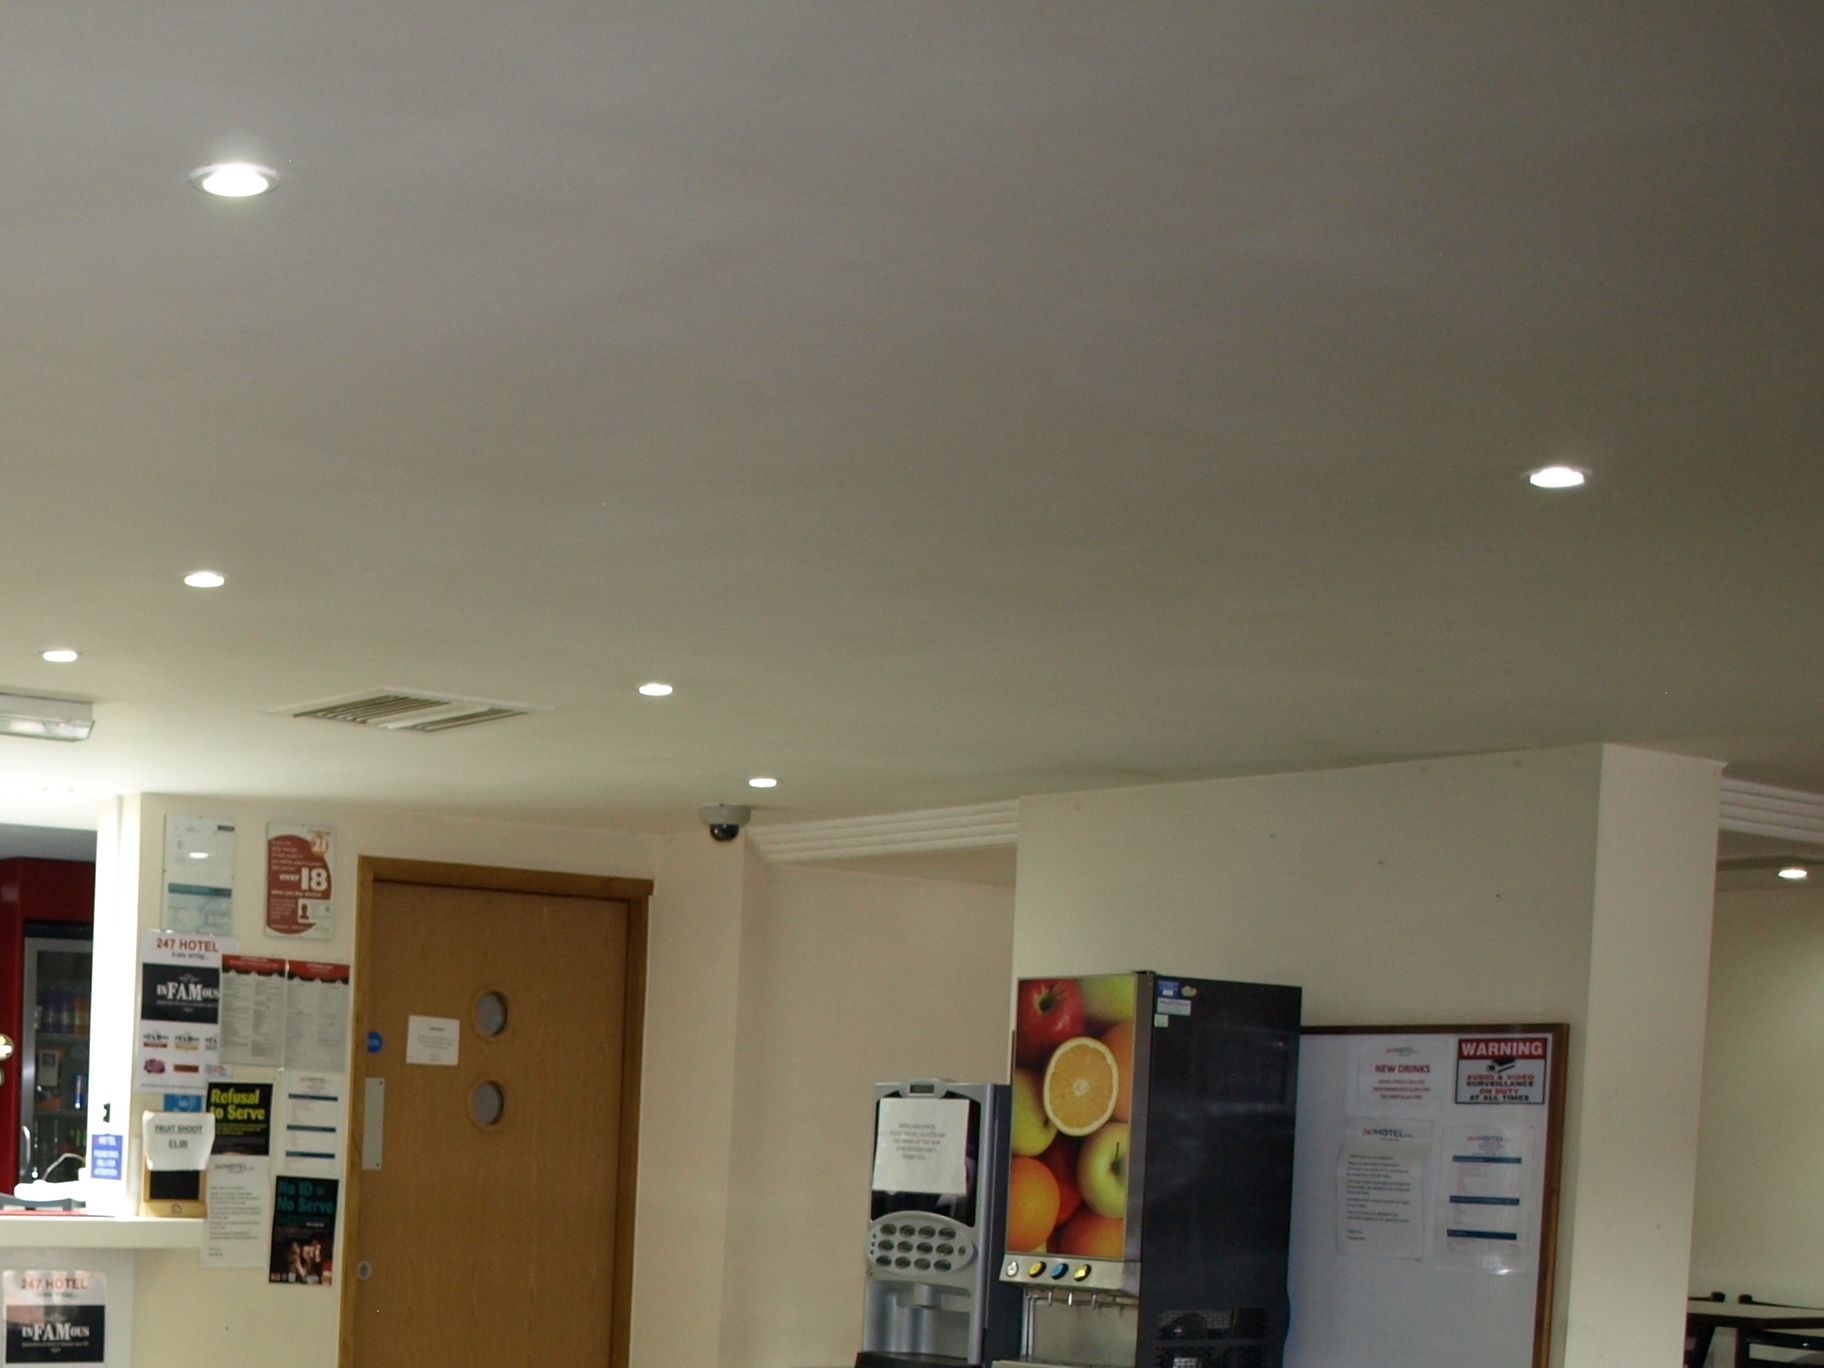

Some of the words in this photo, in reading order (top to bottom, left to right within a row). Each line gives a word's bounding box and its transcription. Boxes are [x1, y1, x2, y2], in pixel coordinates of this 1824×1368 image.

[279, 872, 300, 882] over
[300, 867, 328, 891] 18
[156, 938, 175, 949] 247
[179, 939, 218, 952] HOTEL
[1460, 1041, 1543, 1057] WARNING
[1375, 1064, 1396, 1073] NEW
[1398, 1064, 1431, 1073] DRINKS
[1466, 1080, 1534, 1088] SURVEILLANCE
[1479, 1087, 1492, 1095] ON
[1495, 1087, 1520, 1095] DUTY
[210, 1087, 260, 1105] Refusal
[210, 1106, 224, 1119] to
[227, 1105, 265, 1121] Serve
[278, 1181, 295, 1195] No
[298, 1181, 314, 1197] ID
[277, 1196, 294, 1212] No
[298, 1197, 334, 1214] Serve
[21, 1279, 41, 1290] 247
[45, 1279, 87, 1290] HOTEL
